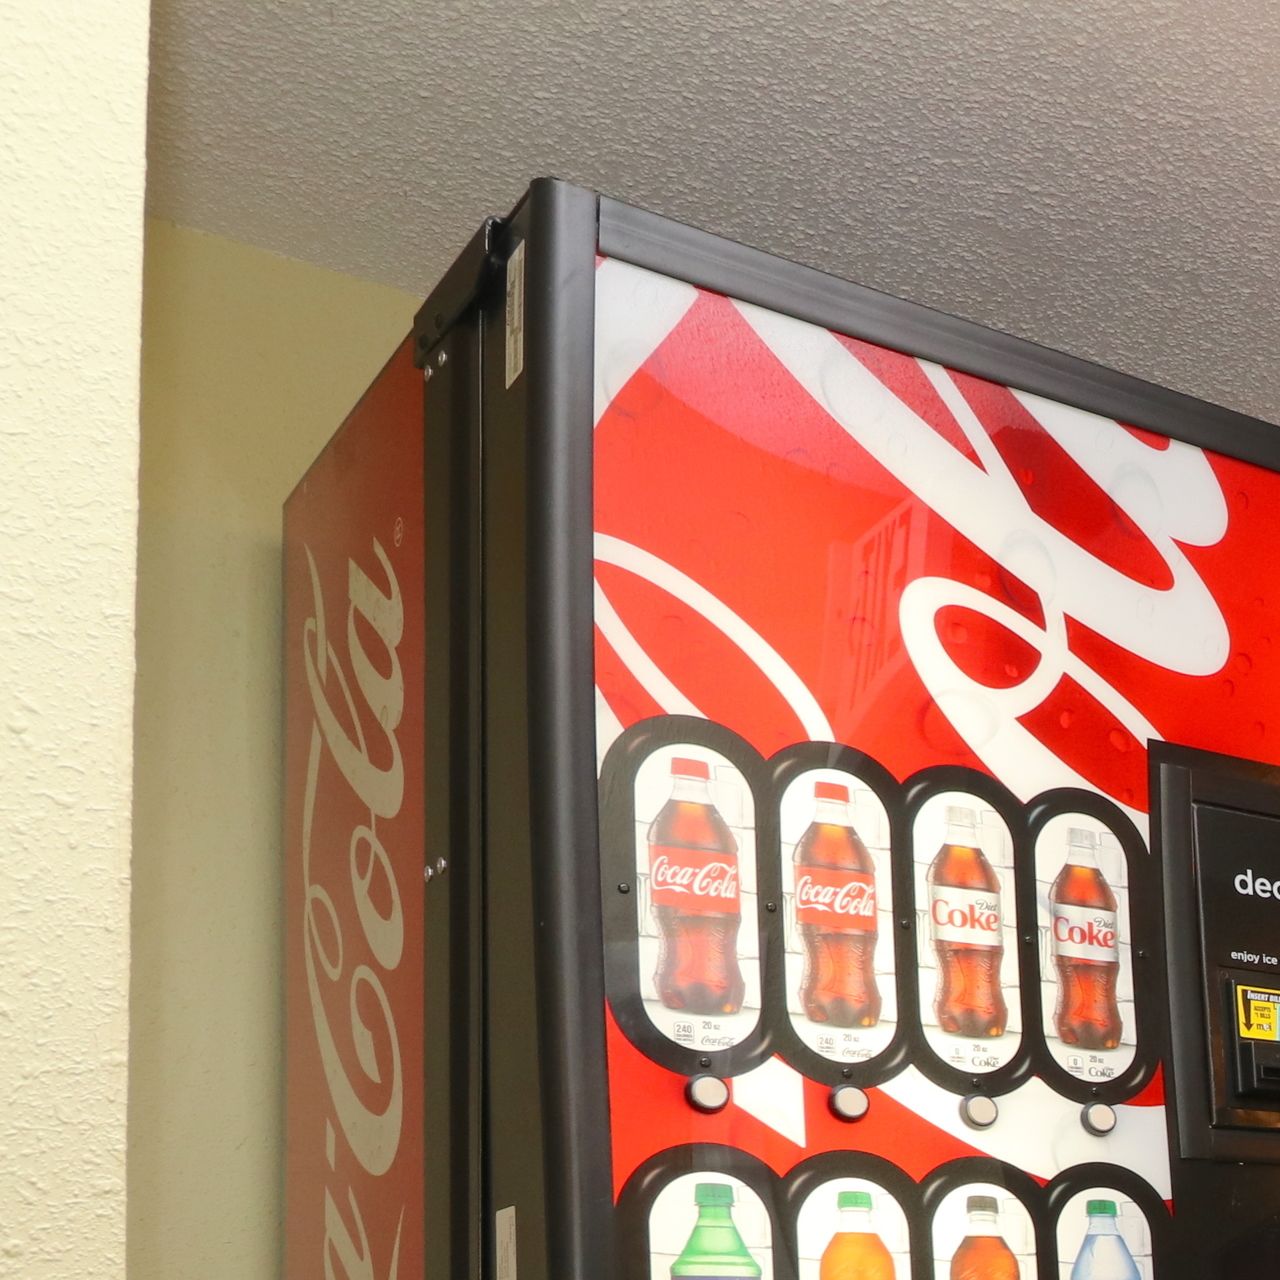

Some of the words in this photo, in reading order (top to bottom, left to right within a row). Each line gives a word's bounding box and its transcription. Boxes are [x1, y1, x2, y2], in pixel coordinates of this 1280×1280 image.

[651, 855, 738, 898] Coca-Cola
[796, 875, 875, 917] Coca-Cola
[976, 899, 998, 912] Diet
[931, 899, 999, 932] Coke
[1094, 917, 1115, 930] Diet
[1053, 916, 1116, 949] Coke
[1230, 951, 1260, 964] enjoy
[1262, 954, 1278, 965] ice
[676, 1024, 692, 1034] 240
[702, 1021, 712, 1030] 20
[843, 1034, 852, 1042] 20
